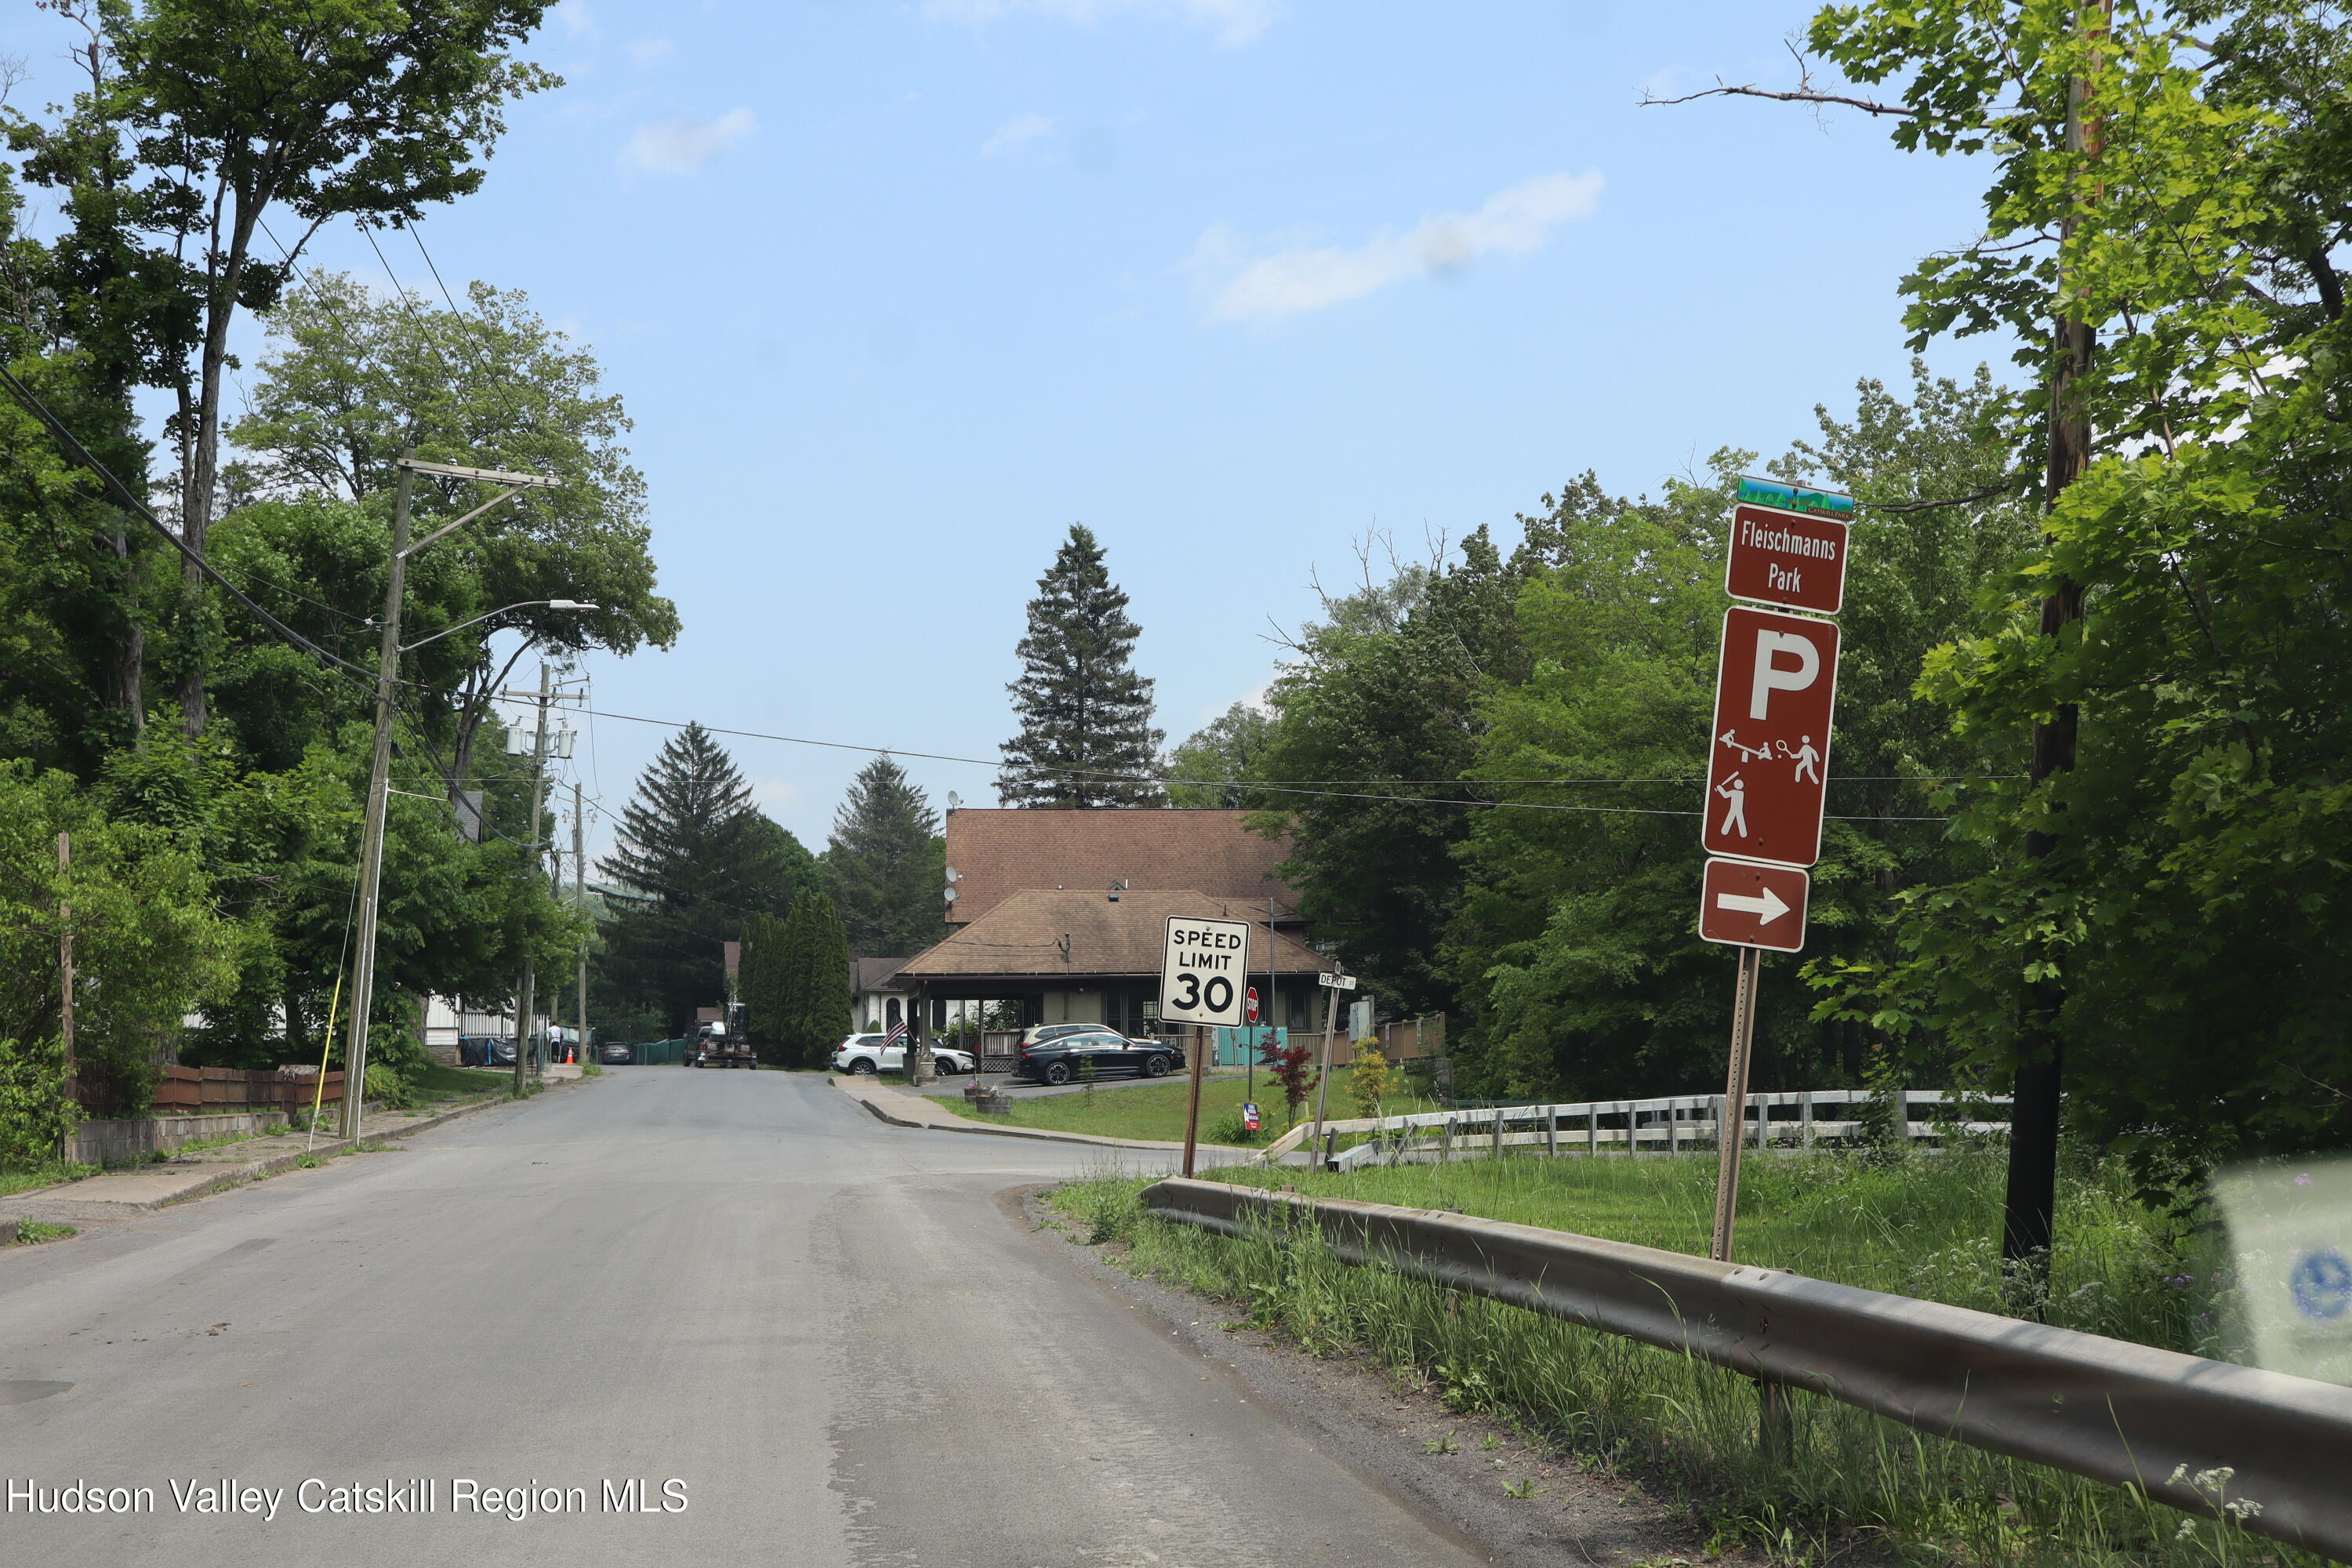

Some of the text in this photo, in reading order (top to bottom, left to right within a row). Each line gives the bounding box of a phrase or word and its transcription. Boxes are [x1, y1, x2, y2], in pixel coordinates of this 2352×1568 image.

[1741, 520, 1836, 561] Fleischmanns
[1768, 563, 1802, 593] Park
[1749, 628, 1820, 721] P
[1173, 929, 1242, 949] SPEED
[1179, 951, 1232, 971] LIMIT
[1171, 972, 1234, 1014] 30
[1321, 975, 1346, 986] DEPOT
[1247, 997, 1258, 1012] STOP
